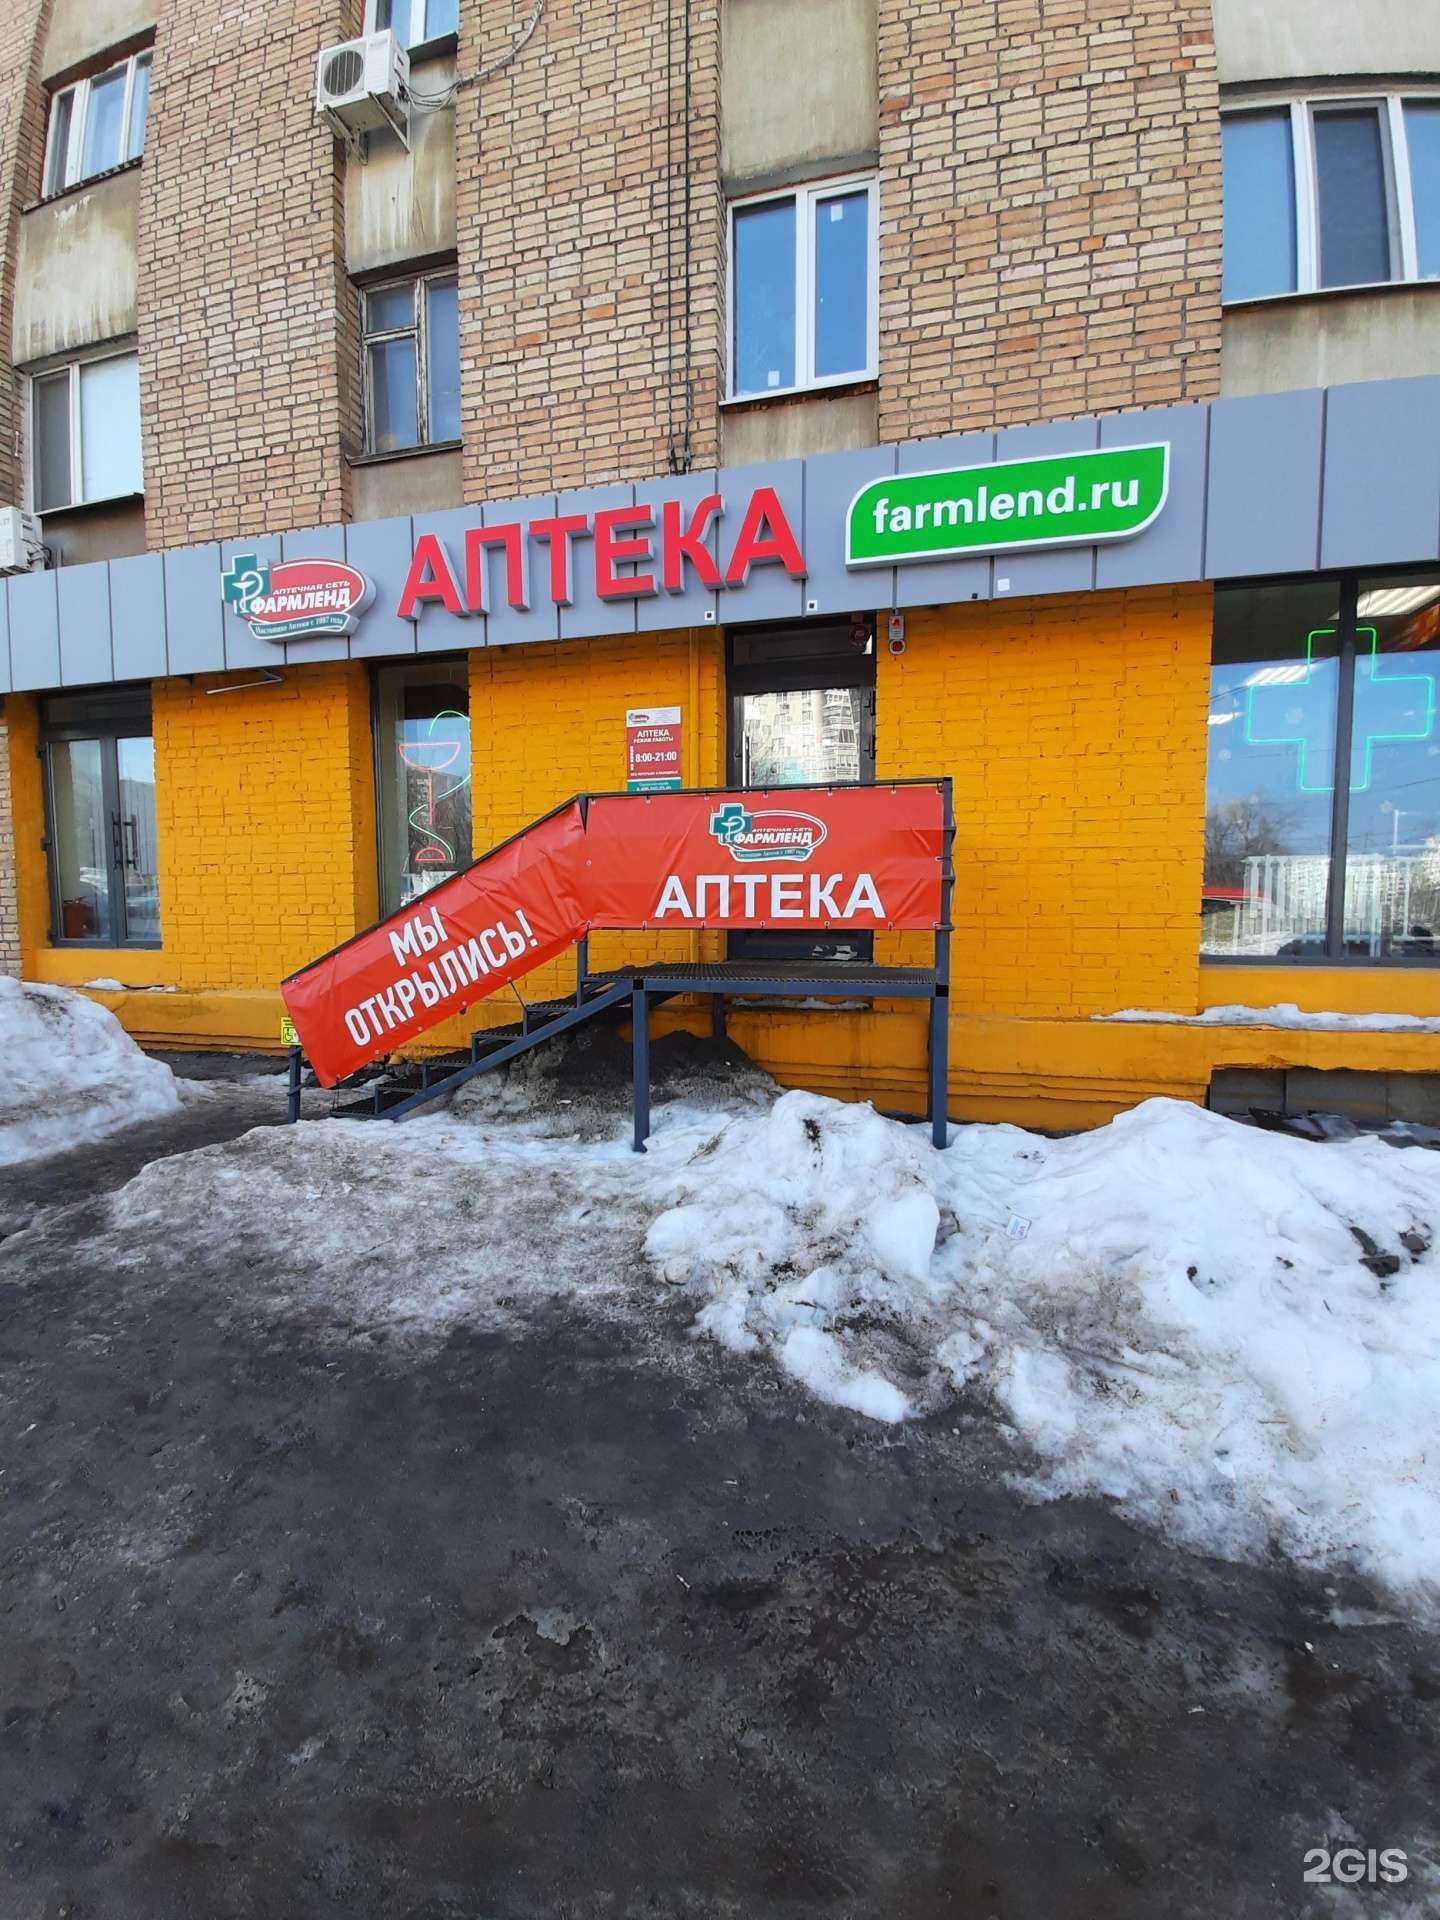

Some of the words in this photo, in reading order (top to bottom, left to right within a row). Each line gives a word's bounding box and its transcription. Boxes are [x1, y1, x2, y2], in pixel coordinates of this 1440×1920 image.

[872, 476, 1140, 534] farmlend.ru
[397, 487, 809, 621] АПТЕКА
[250, 588, 350, 614] ФАРМЛЕНД
[272, 584, 323, 595] АПТЕЧНАЯ
[325, 580, 350, 589] СЕТЬ
[636, 728, 670, 738] АПТЕКА
[635, 751, 677, 763] 8:00-21:00
[735, 831, 813, 846] ФАРМЛЕНД
[654, 873, 886, 919] АПТЕКА
[388, 906, 449, 968] МЫ
[344, 908, 539, 1047] ОТКРЫЛИСЬ!
